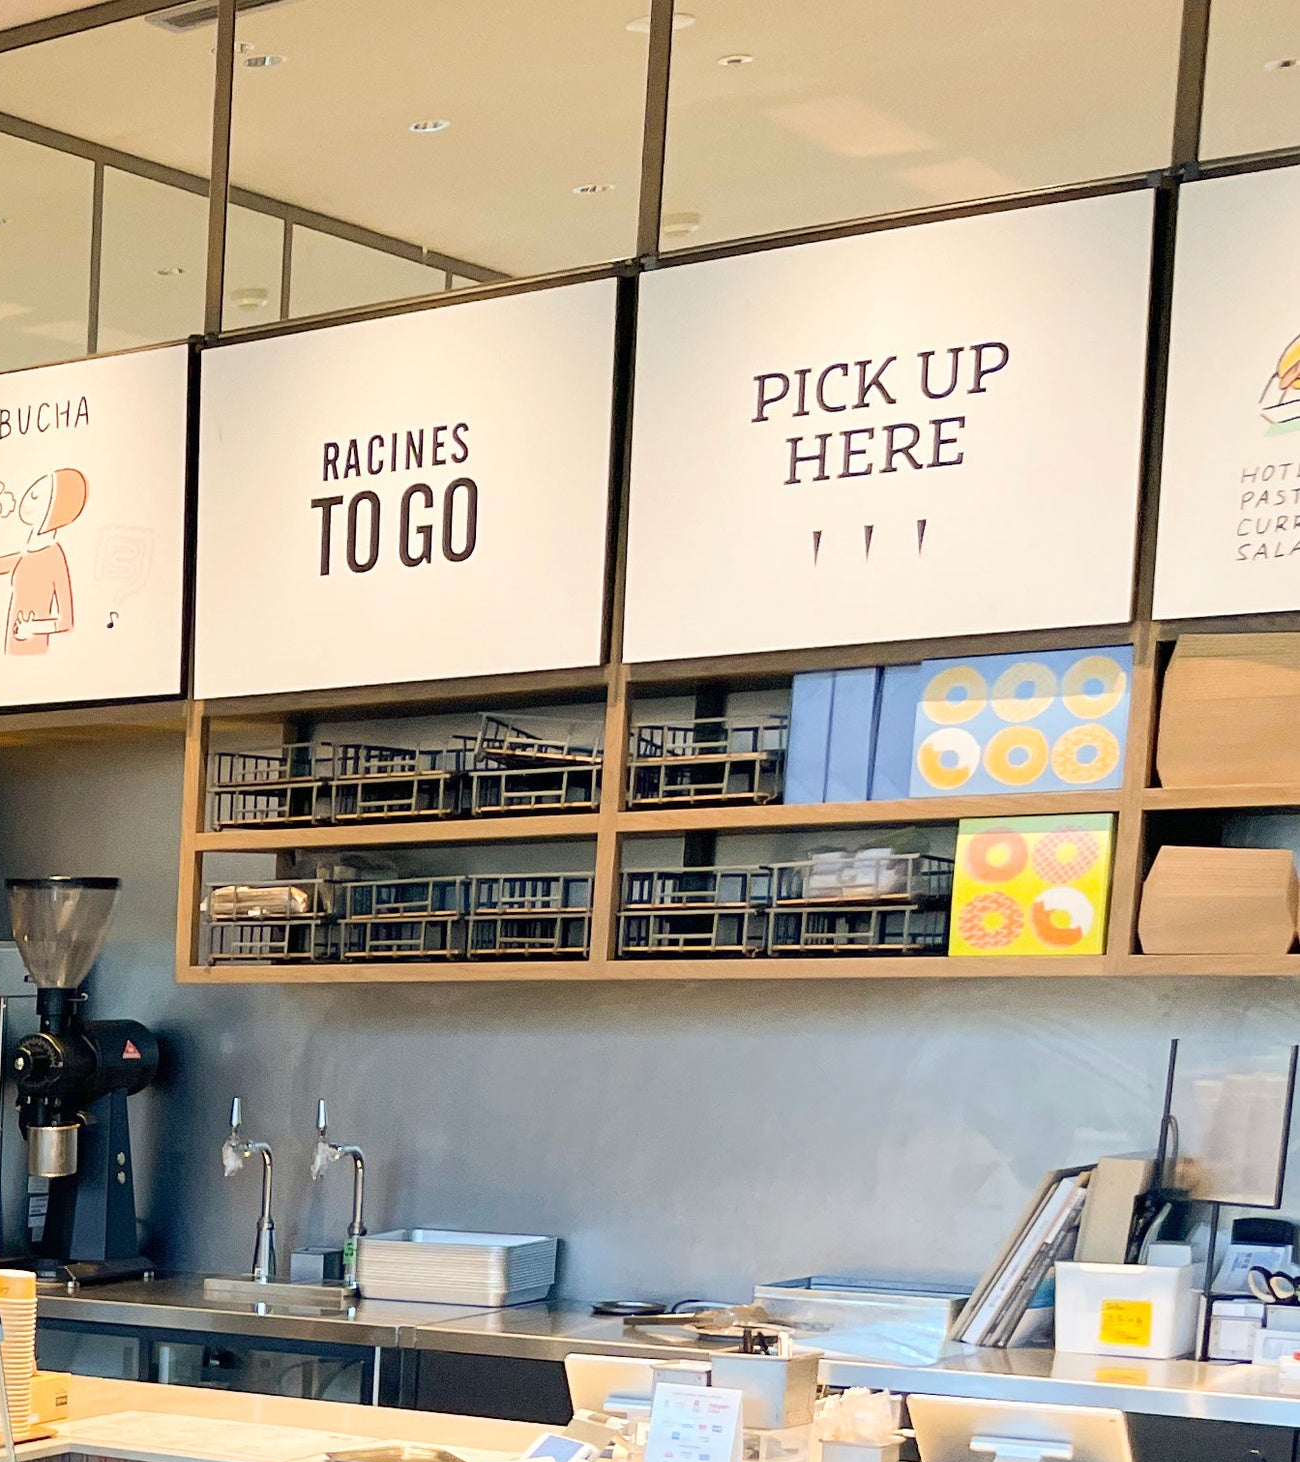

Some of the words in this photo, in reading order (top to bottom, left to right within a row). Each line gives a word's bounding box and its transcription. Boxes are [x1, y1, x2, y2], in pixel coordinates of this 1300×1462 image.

[750, 356, 896, 425] PICK
[919, 341, 1011, 400] UP
[321, 423, 471, 482] RACINES
[783, 416, 967, 486] HERE
[311, 491, 379, 577] TO
[399, 476, 479, 570] GO
